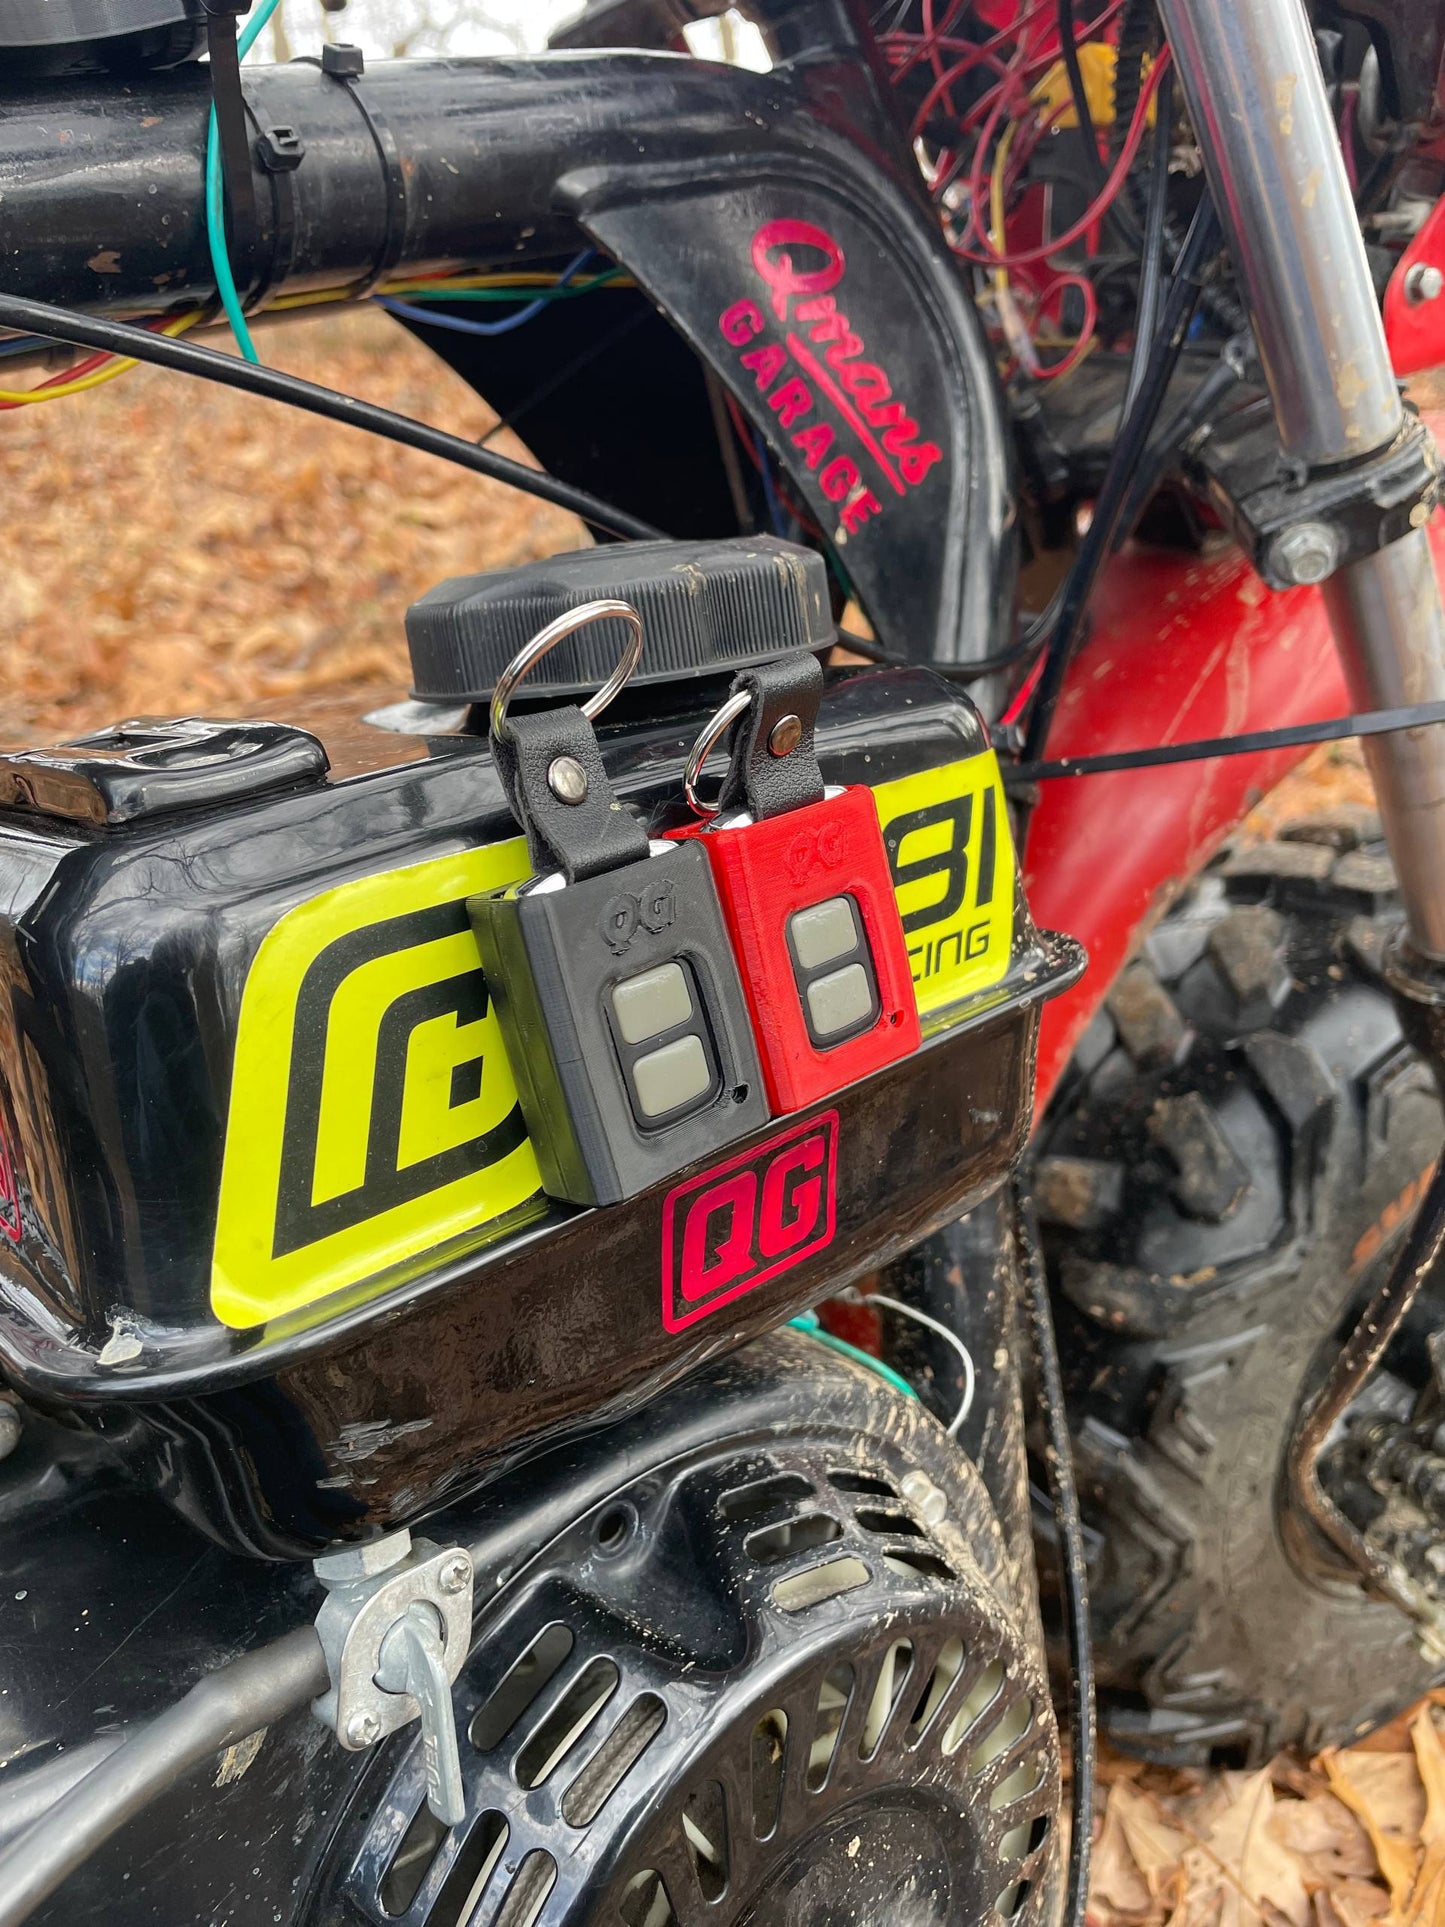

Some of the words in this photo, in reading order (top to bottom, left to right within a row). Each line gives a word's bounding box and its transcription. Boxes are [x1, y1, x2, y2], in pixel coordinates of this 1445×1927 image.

[719, 297, 882, 535] GARAGE
[751, 218, 943, 486] Qmans
[597, 879, 677, 956] QG
[680, 1134, 827, 1303] QG
